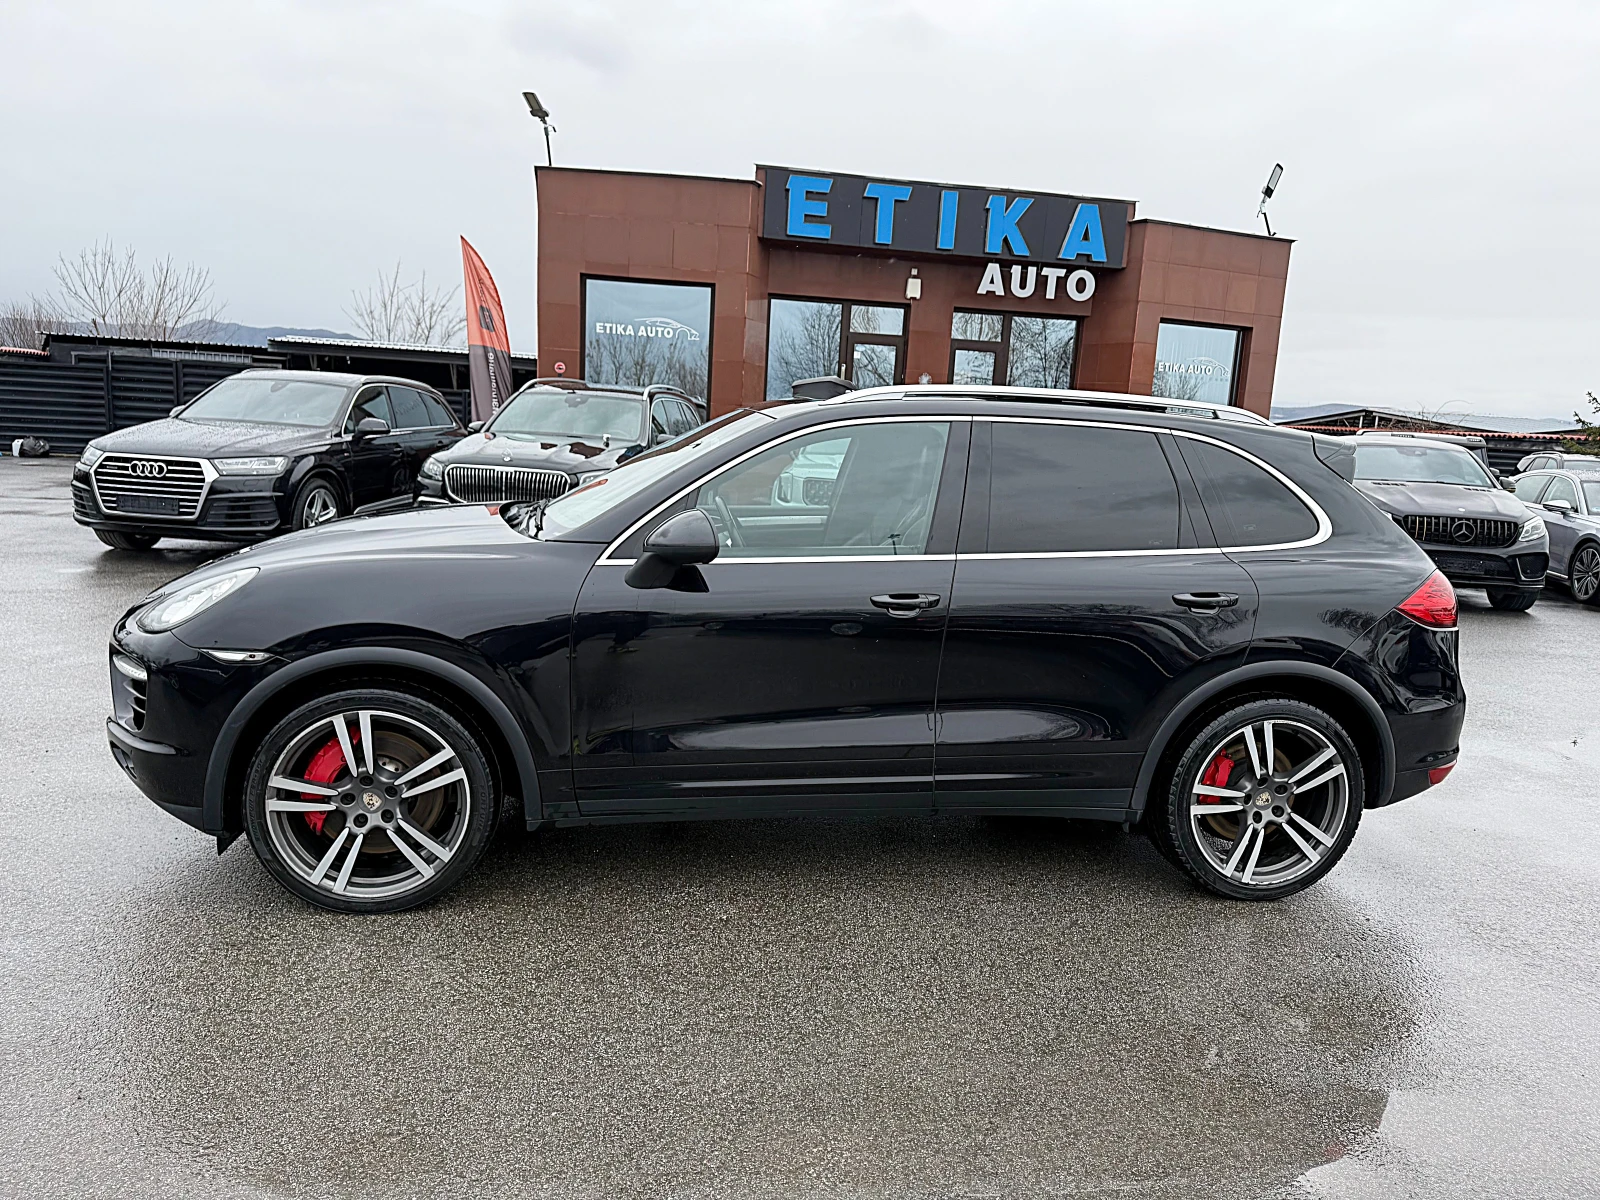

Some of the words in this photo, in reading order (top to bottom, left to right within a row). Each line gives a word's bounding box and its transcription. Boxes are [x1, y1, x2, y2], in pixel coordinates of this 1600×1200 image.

[785, 174, 1107, 262] ETIKA
[977, 263, 1096, 302] AUTO
[596, 322, 635, 336] ETIKA
[638, 325, 674, 339] AUTO
[1158, 361, 1185, 374] ETIKA
[1187, 364, 1213, 376] AUTO
